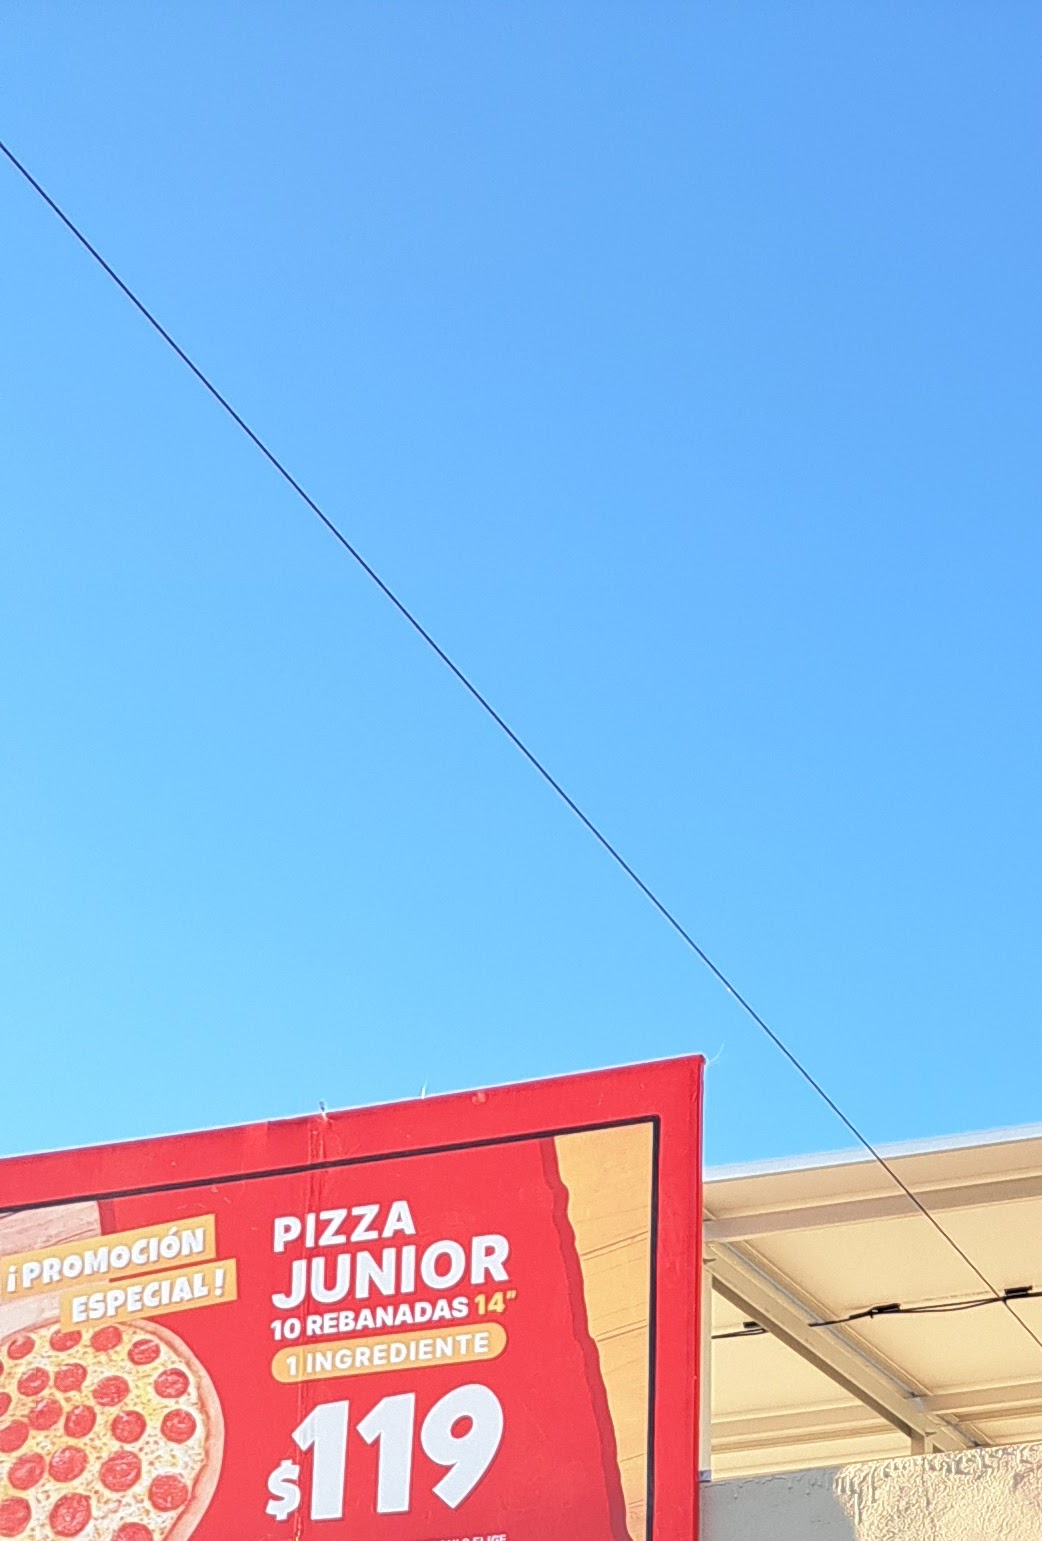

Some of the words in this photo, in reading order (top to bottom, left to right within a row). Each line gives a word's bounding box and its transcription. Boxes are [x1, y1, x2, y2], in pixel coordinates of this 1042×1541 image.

[273, 1200, 416, 1253] PIZZA
[271, 1234, 510, 1310] JUNIOR
[270, 1318, 301, 1341] 10
[306, 1297, 469, 1336] REBANADAS
[286, 1356, 297, 1376] 1
[306, 1331, 490, 1373] INGREDIENTE
[265, 1383, 504, 1521] $119
